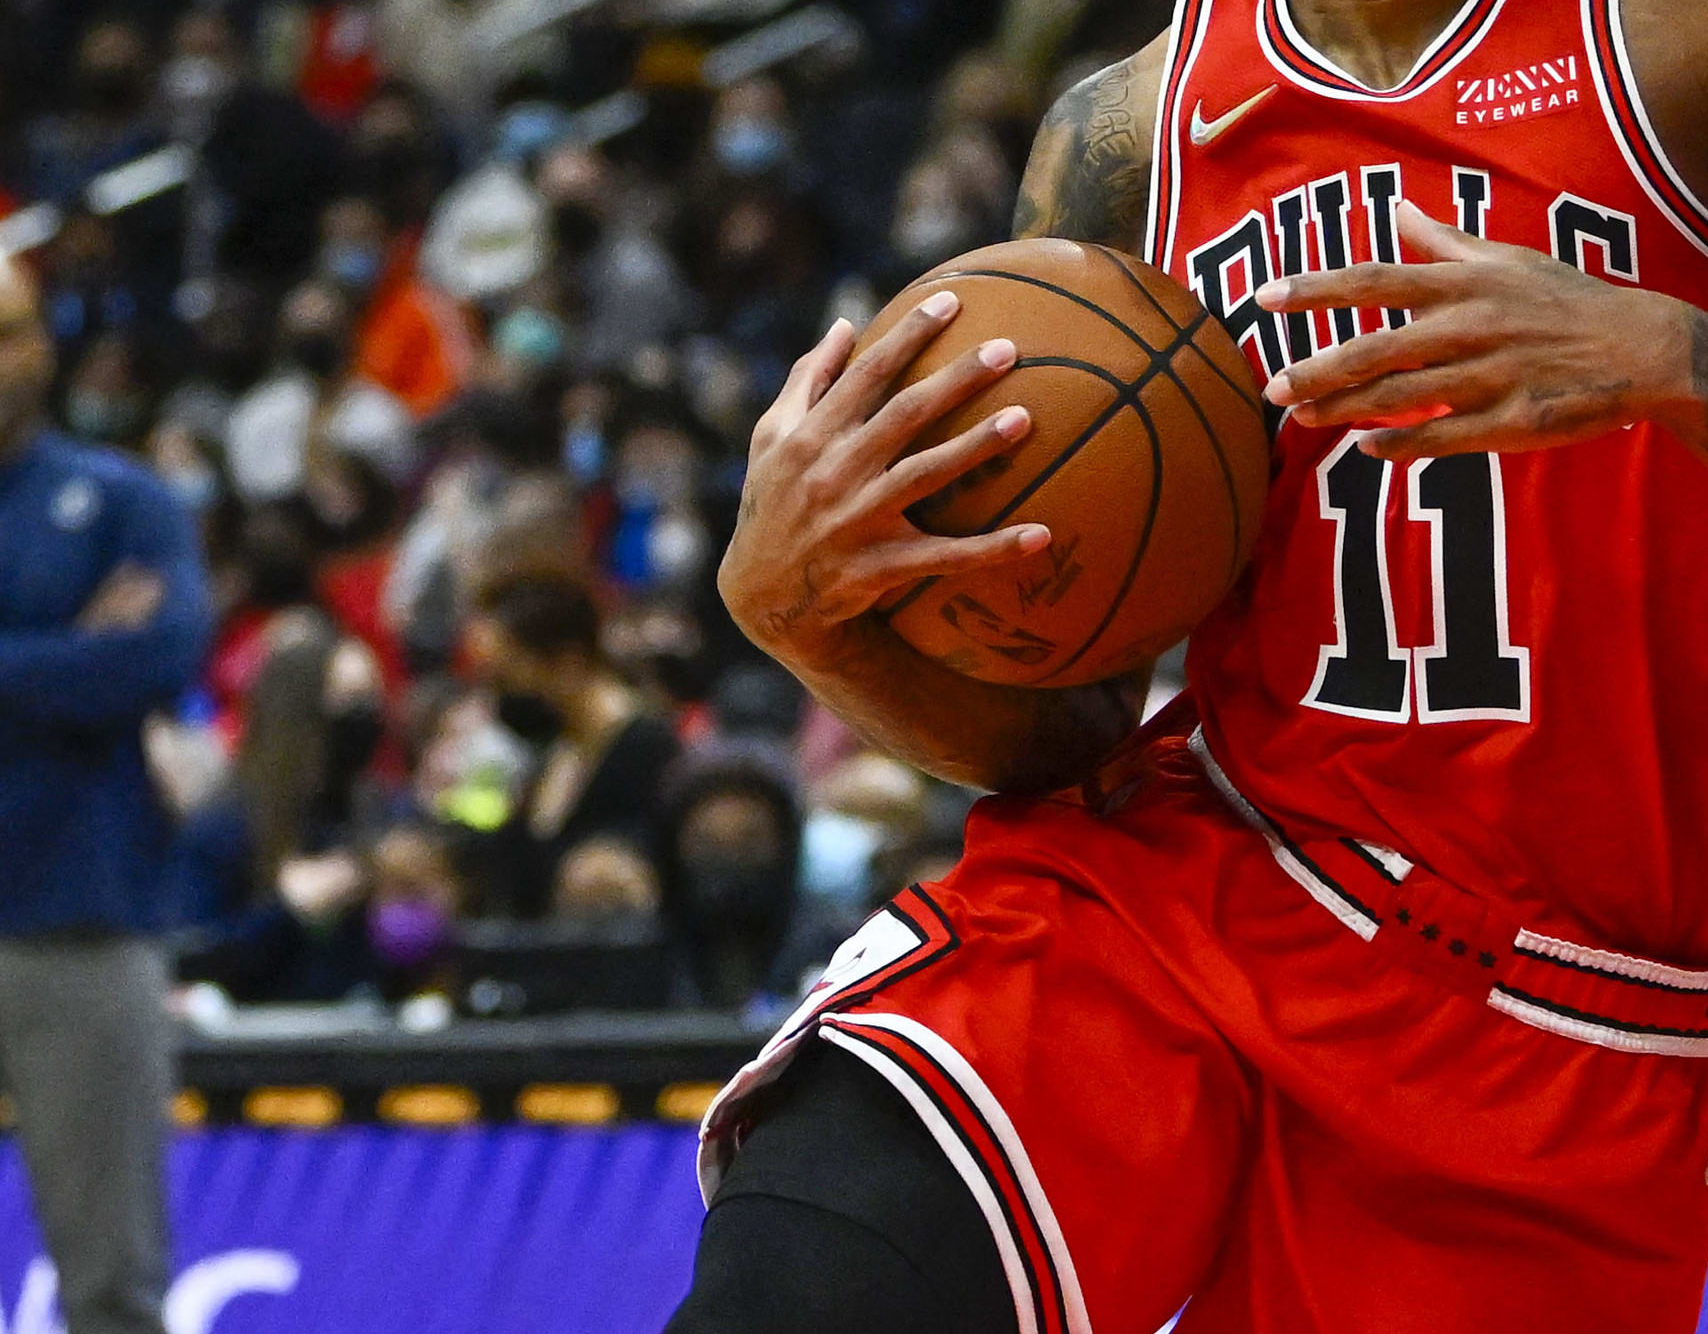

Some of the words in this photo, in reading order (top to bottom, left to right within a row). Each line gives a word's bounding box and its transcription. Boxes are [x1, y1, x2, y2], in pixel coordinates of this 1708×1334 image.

[1456, 54, 1577, 104] ZENNI
[1455, 88, 1579, 125] EYEWEAR
[1298, 428, 1531, 725] 11
